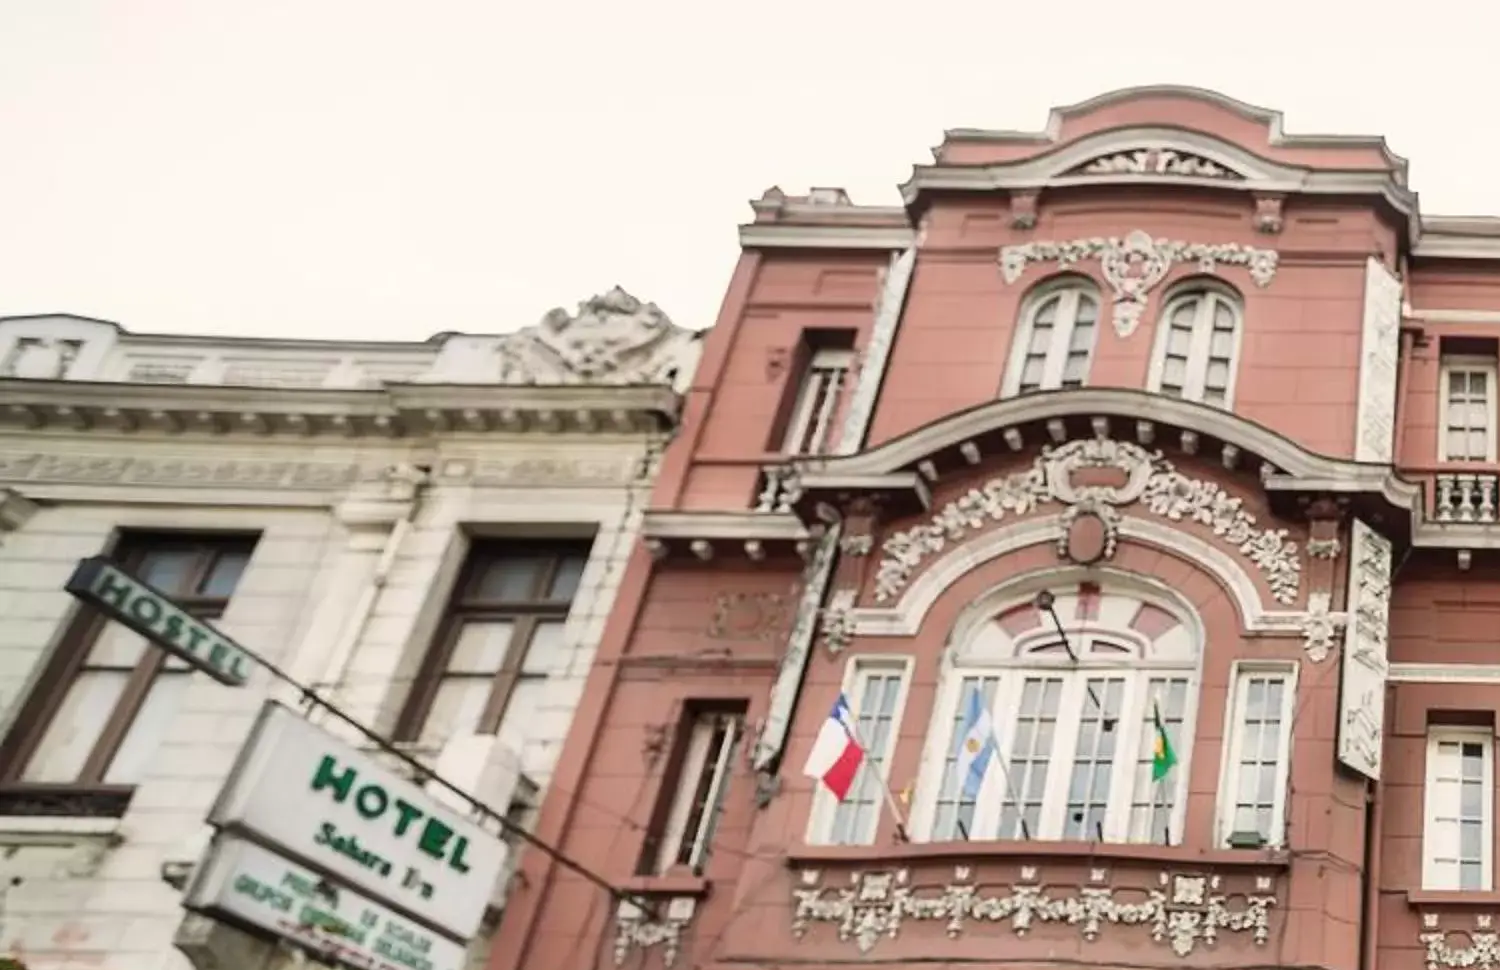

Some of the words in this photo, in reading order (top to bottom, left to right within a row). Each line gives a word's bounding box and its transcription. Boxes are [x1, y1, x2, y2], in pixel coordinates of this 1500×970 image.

[98, 574, 243, 678] HOSTEL
[310, 754, 470, 873] HOTEL
[314, 822, 393, 878] Sahara
